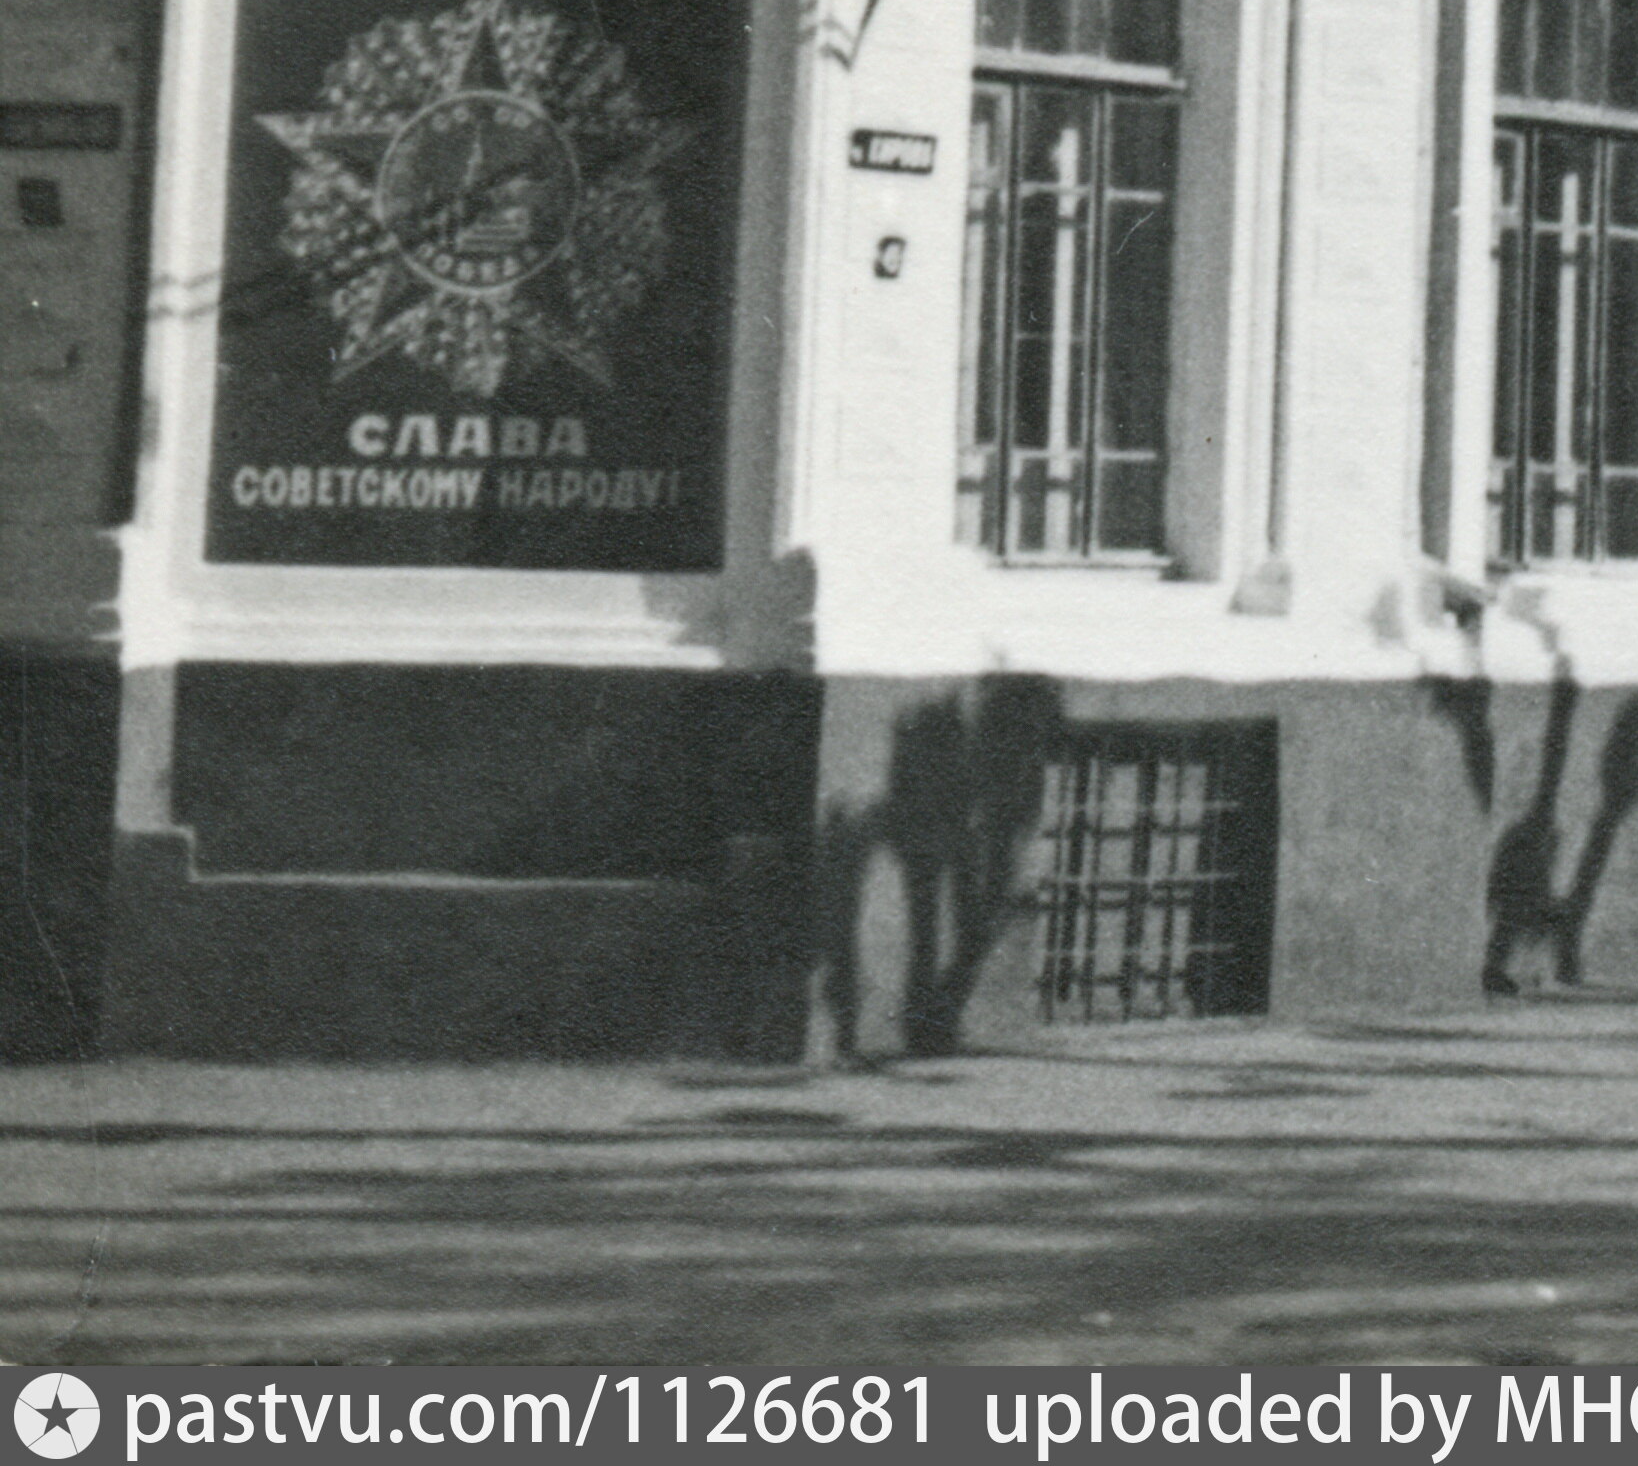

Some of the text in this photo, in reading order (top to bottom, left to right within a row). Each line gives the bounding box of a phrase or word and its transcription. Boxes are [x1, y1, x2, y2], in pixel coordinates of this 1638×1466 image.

[347, 413, 588, 458] СЛАВА
[232, 466, 680, 510] СОВЕТСКОМУ НАРОДУ!
